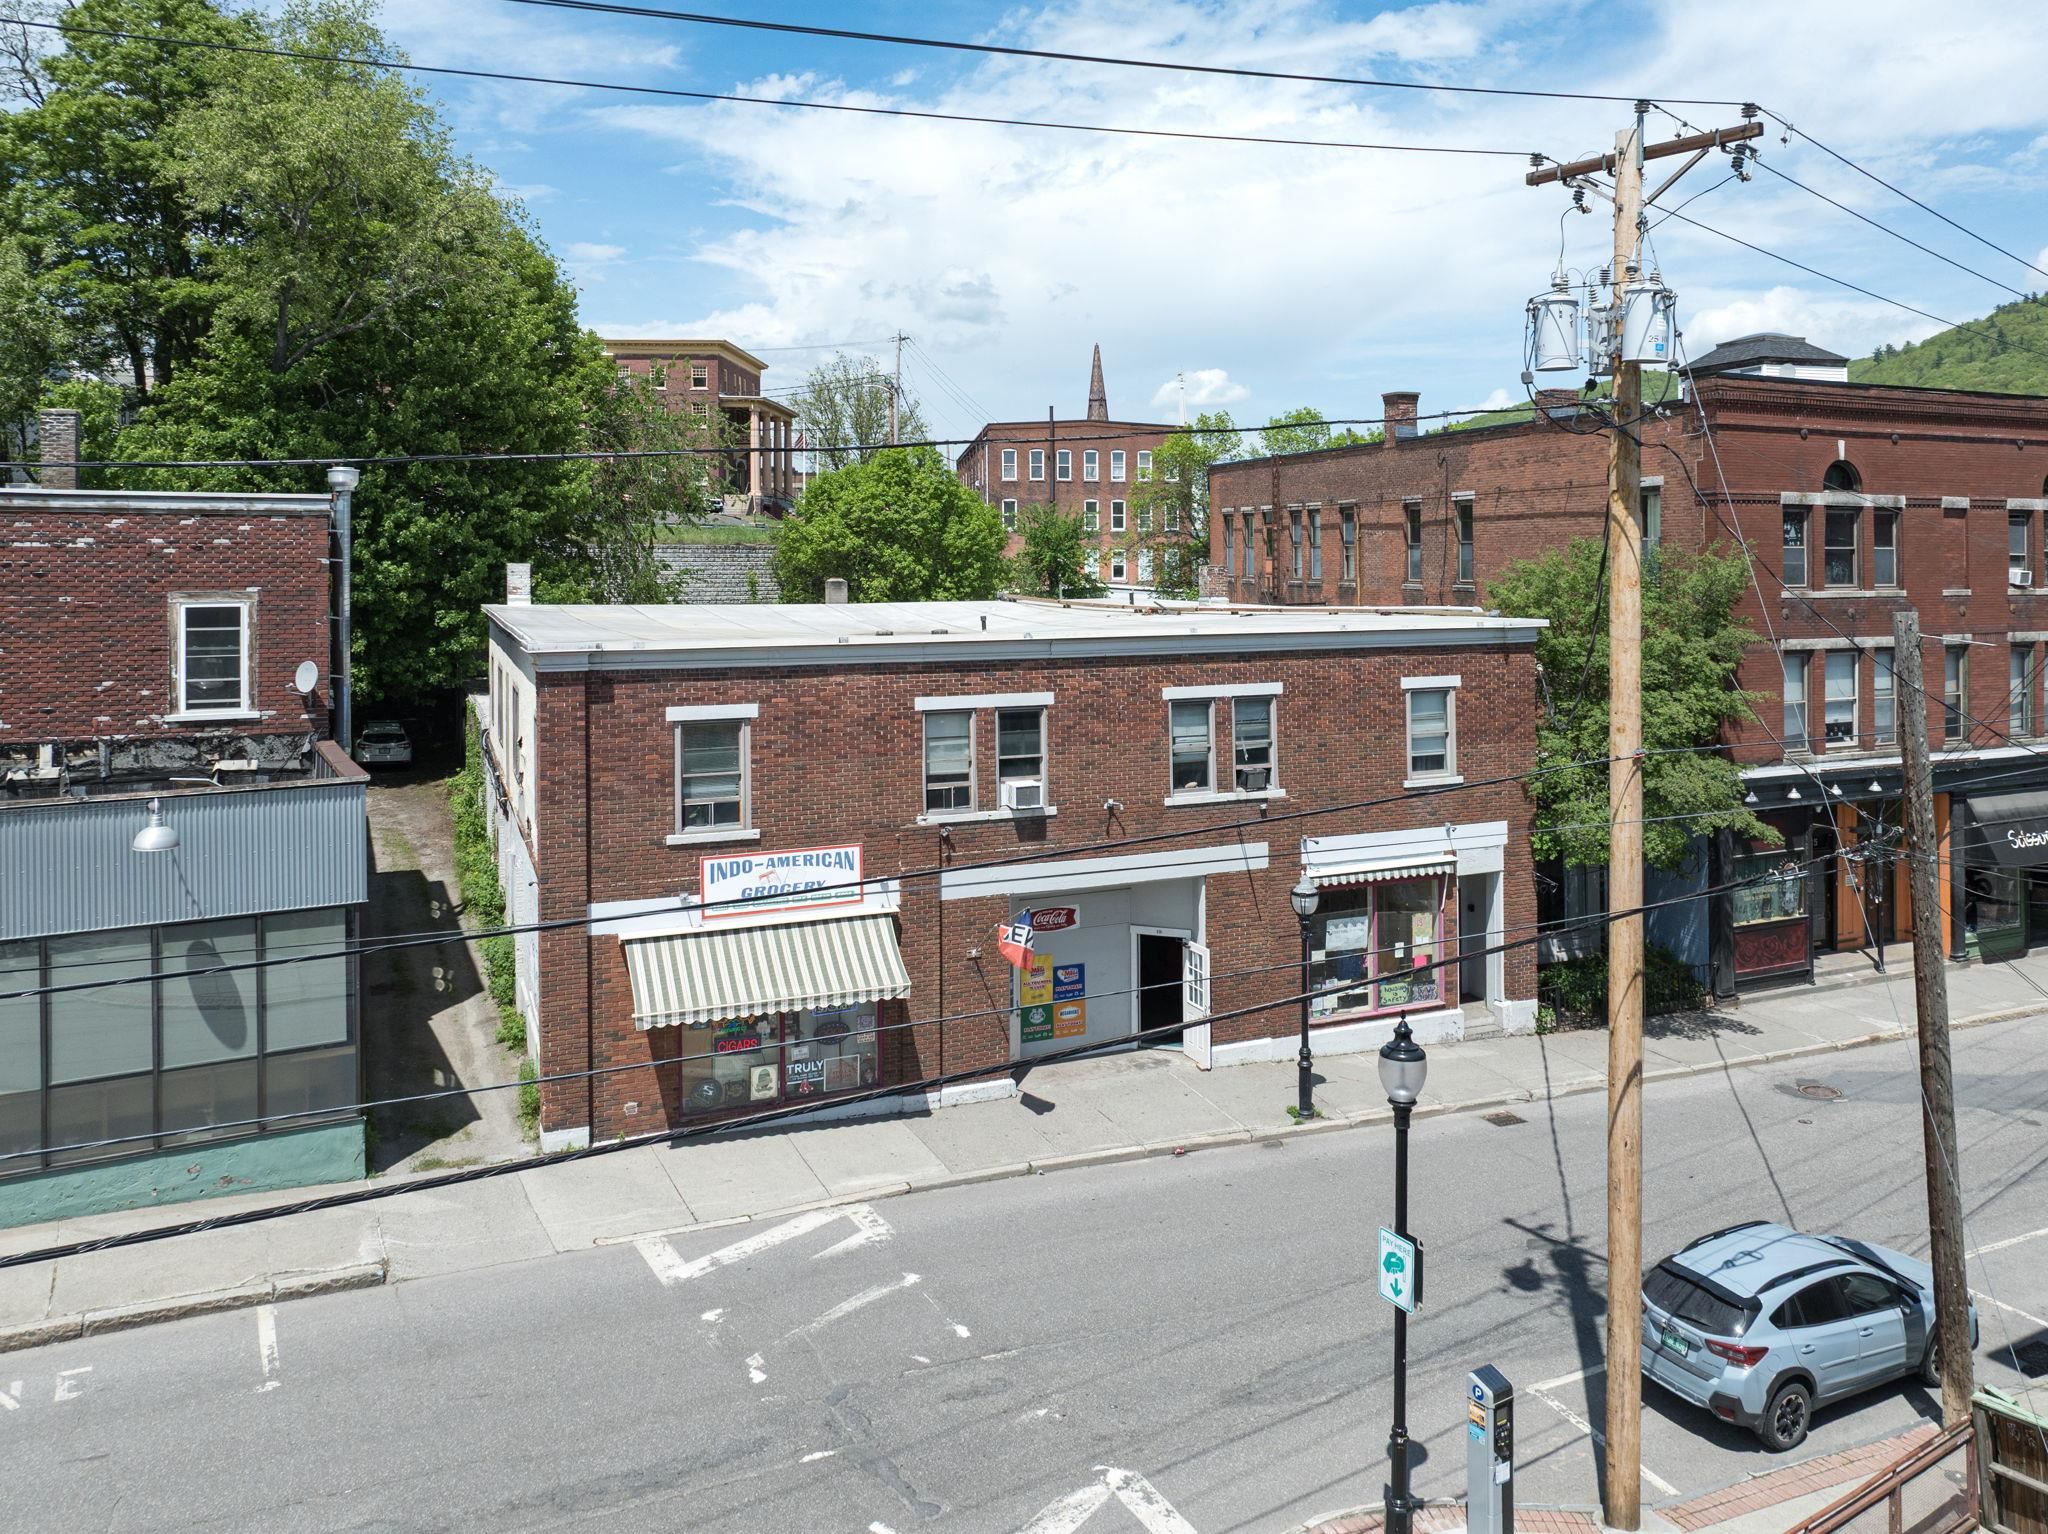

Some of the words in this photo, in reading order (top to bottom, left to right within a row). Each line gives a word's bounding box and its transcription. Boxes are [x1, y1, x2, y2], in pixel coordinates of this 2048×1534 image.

[709, 851, 855, 885] INDO-AMERICAN
[741, 880, 827, 900] GROCERY
[717, 1038, 759, 1054] CIGARS
[786, 1060, 824, 1075] TRULY
[1382, 1235, 1394, 1248] PAY
[1394, 1242, 1412, 1258] HERE
